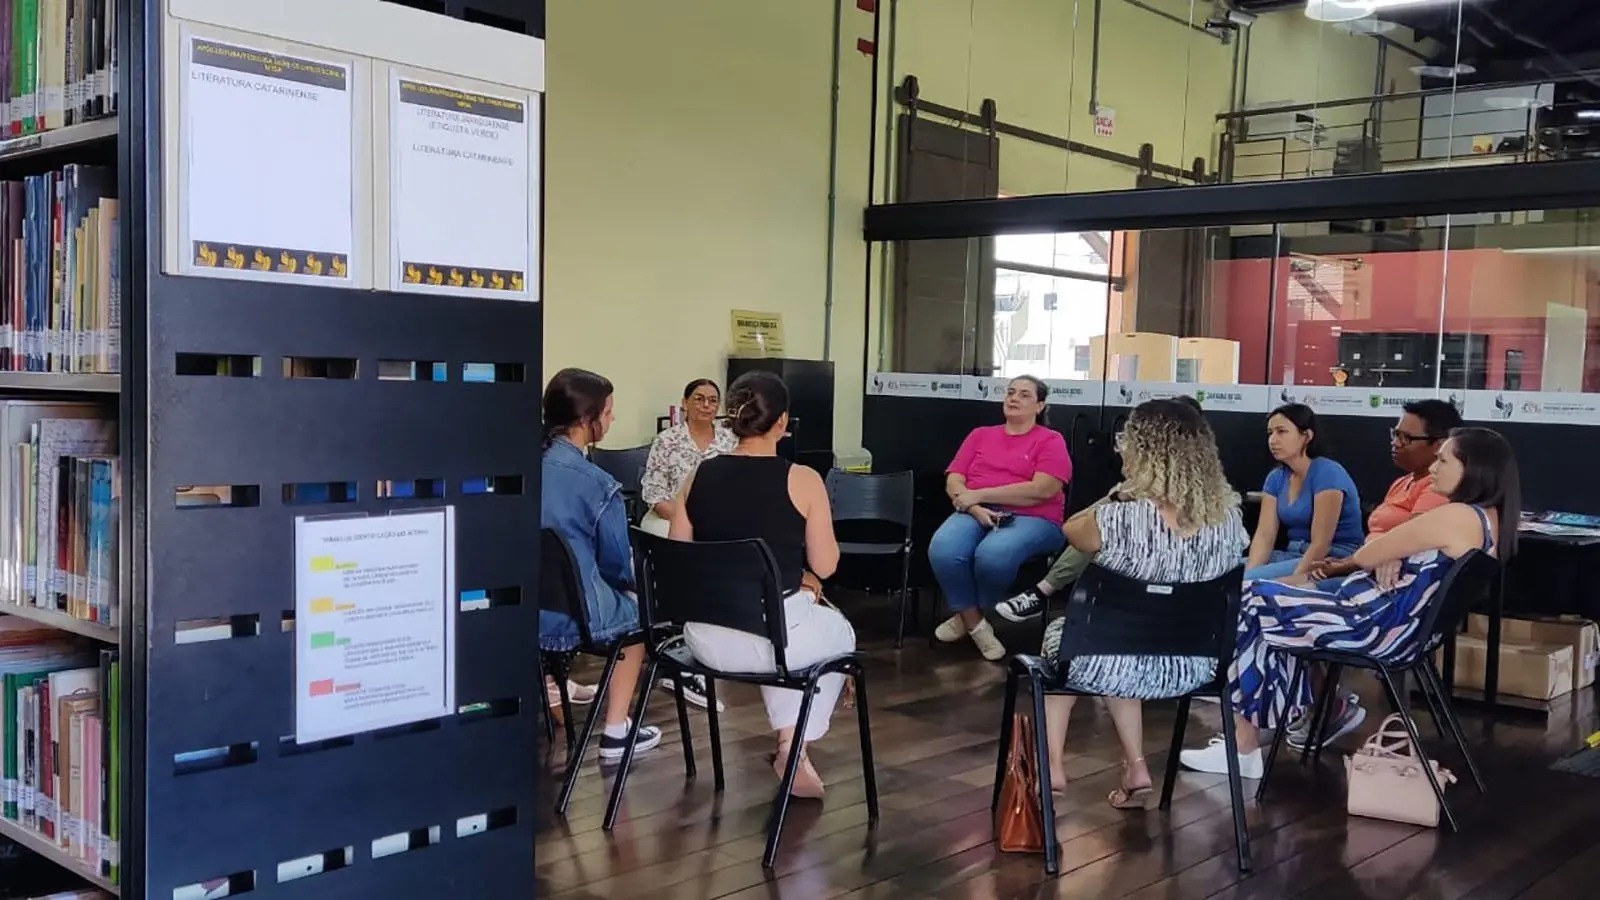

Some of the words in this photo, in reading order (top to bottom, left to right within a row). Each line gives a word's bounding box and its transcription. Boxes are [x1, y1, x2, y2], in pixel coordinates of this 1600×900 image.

[191, 71, 252, 89] LITERATURA
[254, 83, 318, 101] CATARINENSE
[412, 143, 461, 158] LITERATURA
